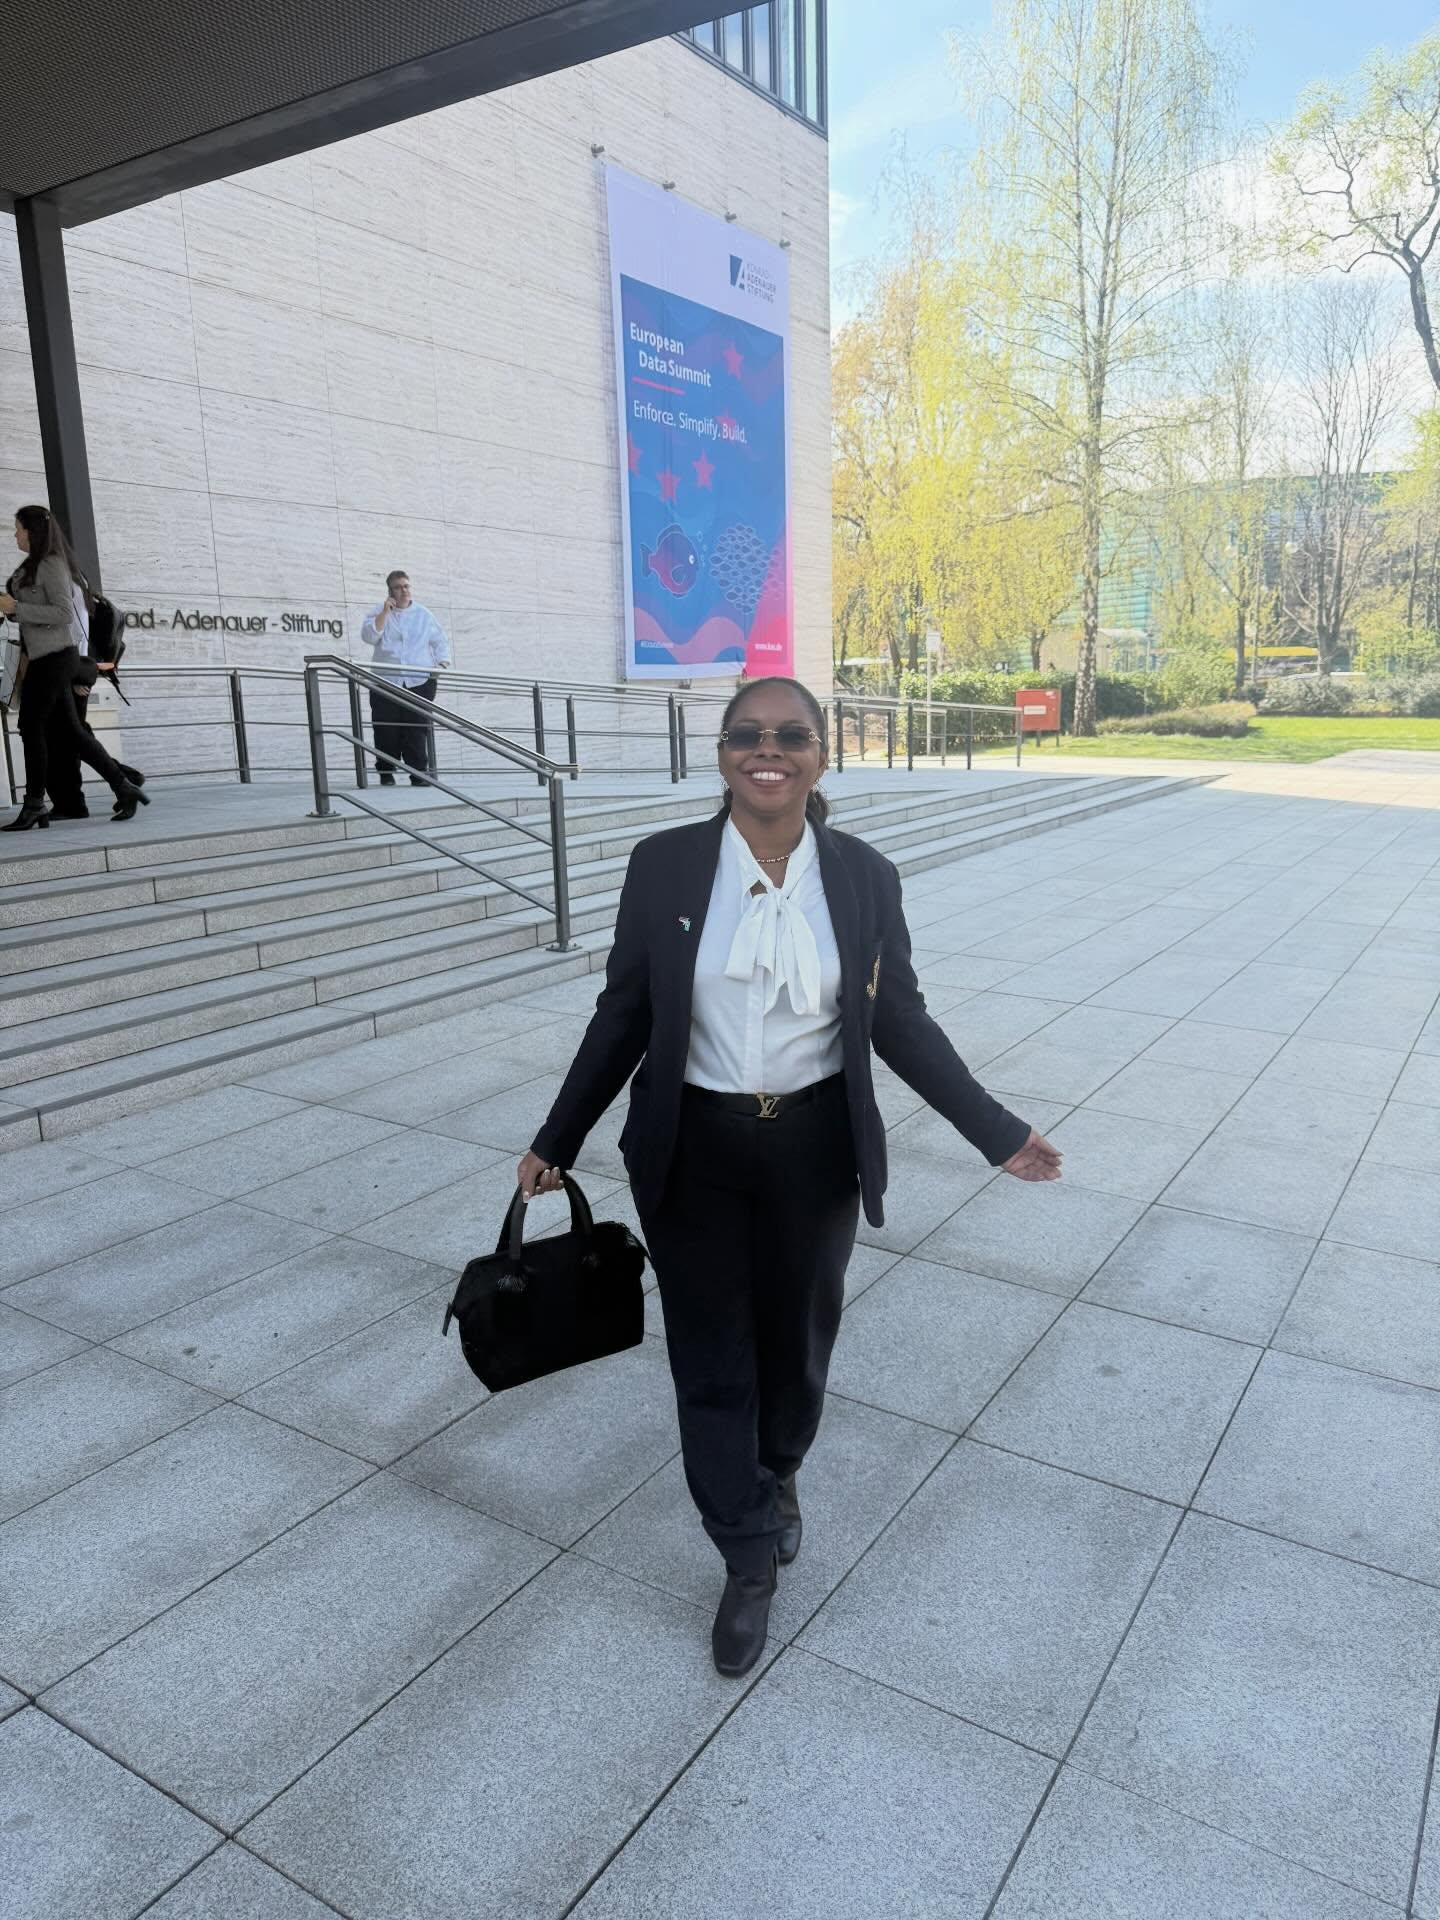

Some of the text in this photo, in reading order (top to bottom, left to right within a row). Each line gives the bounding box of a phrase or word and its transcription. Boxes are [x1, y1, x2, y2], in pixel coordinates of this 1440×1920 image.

[630, 321, 684, 355] European
[639, 350, 711, 387] Data Summit
[634, 400, 747, 444] Enforce. Simplify. Build.
